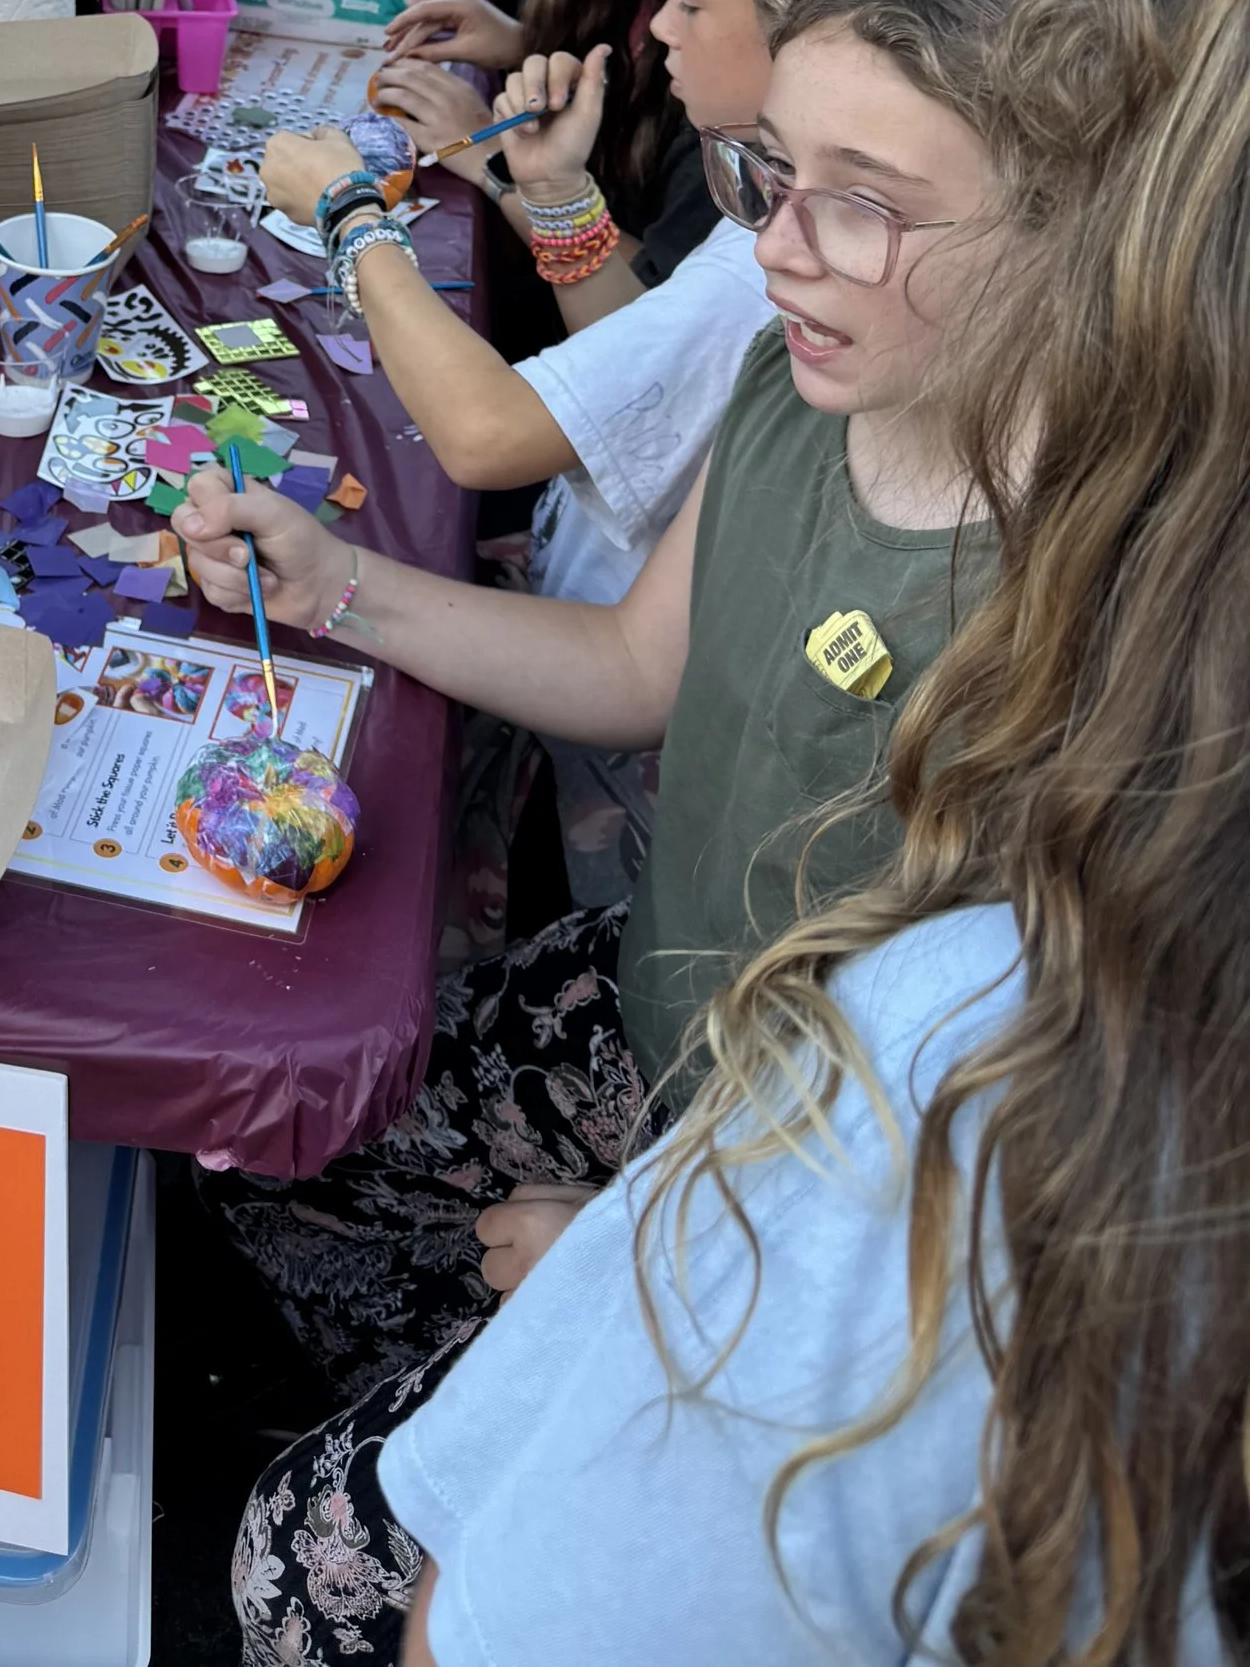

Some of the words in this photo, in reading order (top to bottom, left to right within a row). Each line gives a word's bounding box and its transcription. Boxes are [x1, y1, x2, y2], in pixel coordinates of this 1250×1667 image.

[822, 621, 863, 666] ADMIT
[837, 642, 868, 673] ONE
[101, 753, 126, 789] Squares
[107, 813, 121, 832] Press
[121, 777, 134, 796] tissue
[130, 756, 143, 777] paper
[138, 731, 153, 755] squares
[95, 789, 111, 805] the
[86, 805, 105, 828] Stick
[129, 799, 143, 826] around
[100, 843, 116, 853] 3
[160, 828, 177, 845] Let
[169, 858, 184, 869] 4
